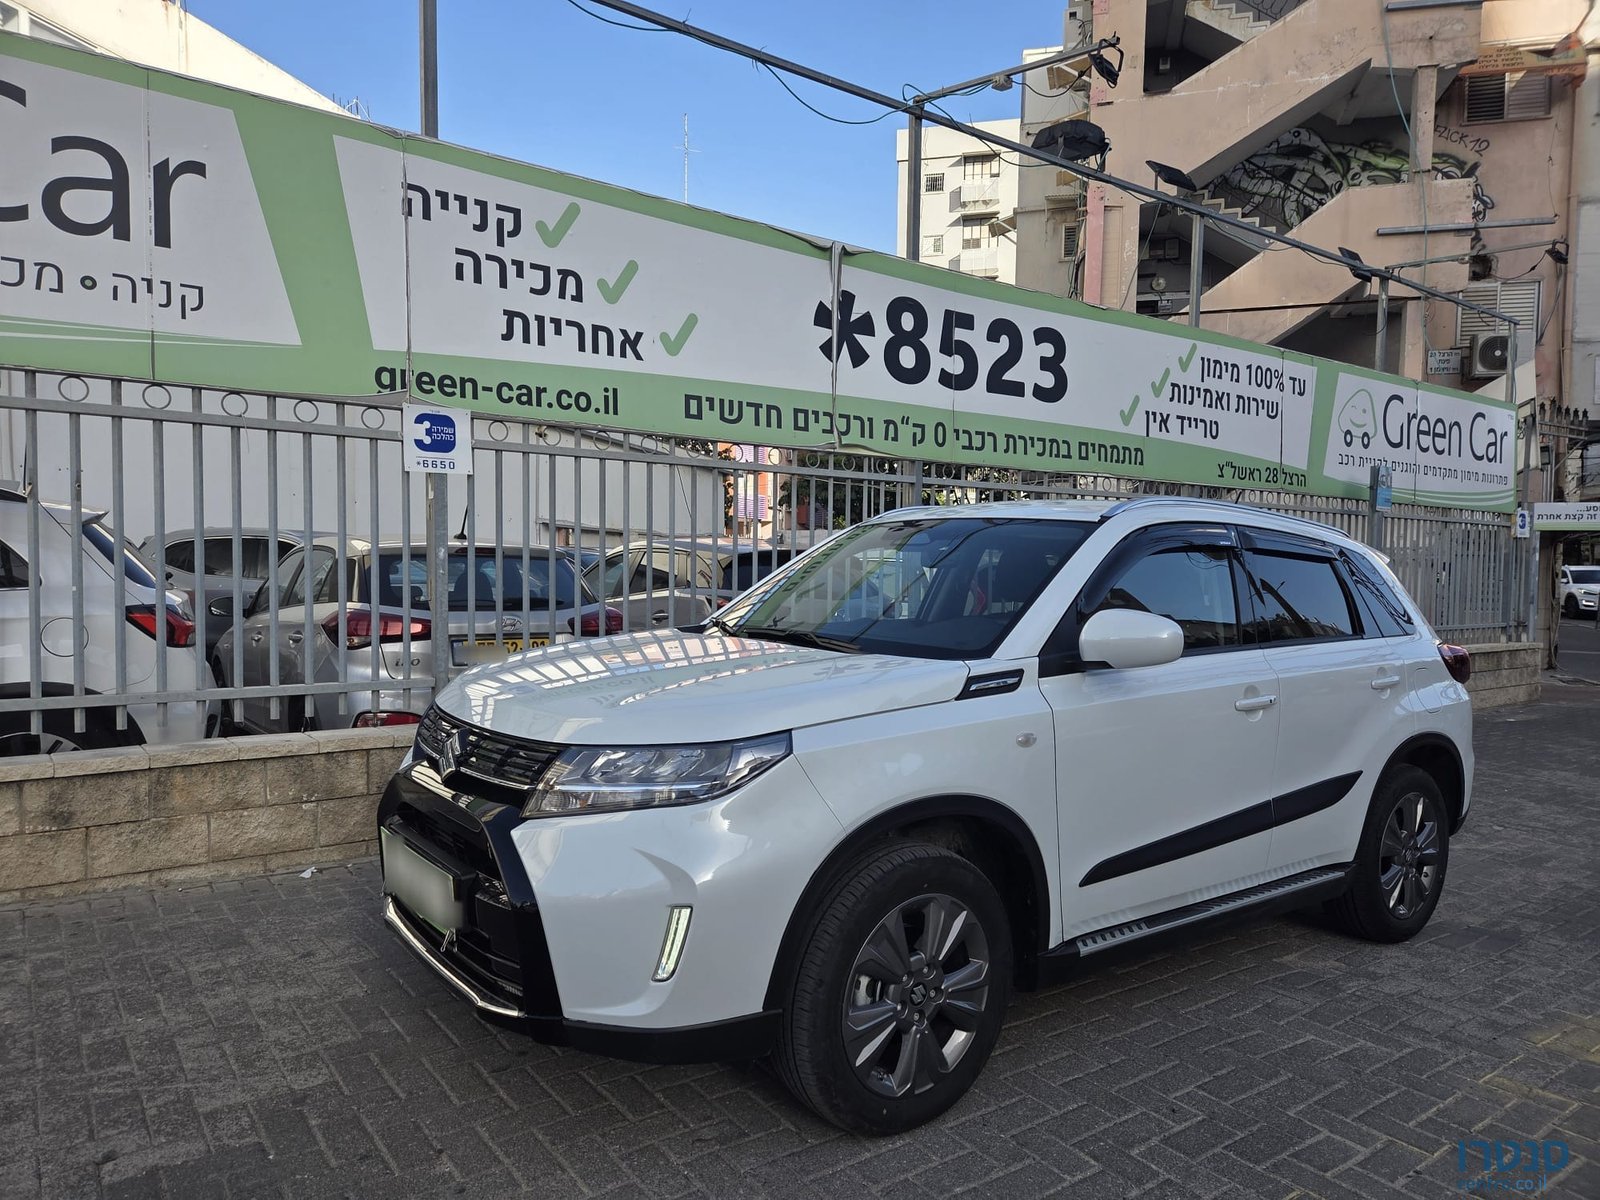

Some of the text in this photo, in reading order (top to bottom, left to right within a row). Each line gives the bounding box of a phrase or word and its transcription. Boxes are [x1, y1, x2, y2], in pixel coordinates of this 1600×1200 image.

[401, 181, 522, 248] קנייה
[454, 247, 584, 304] מכירה
[111, 272, 205, 320] קניה
[501, 308, 645, 362] אחריות
[374, 365, 620, 416] green-car.co.il
[1200, 356, 1307, 397] עד 100% מימון
[684, 393, 783, 430] חדשים
[1169, 381, 1279, 420] שירות ואמינות
[431, 425, 455, 434] שמירה
[793, 407, 874, 440] ורכבים
[933, 421, 947, 448] 0
[1144, 410, 1220, 440] טרייד אין
[1382, 393, 1508, 464] Green Car
[953, 427, 998, 453] רכבי
[1003, 432, 1073, 460] במכירת
[1077, 440, 1145, 467] מתמחים
[1338, 453, 1355, 466] רכב
[1264, 466, 1279, 484] 28
[1281, 467, 1308, 488] הרצל
[1536, 513, 1562, 521] אחרת
[1564, 513, 1584, 522] קצת
